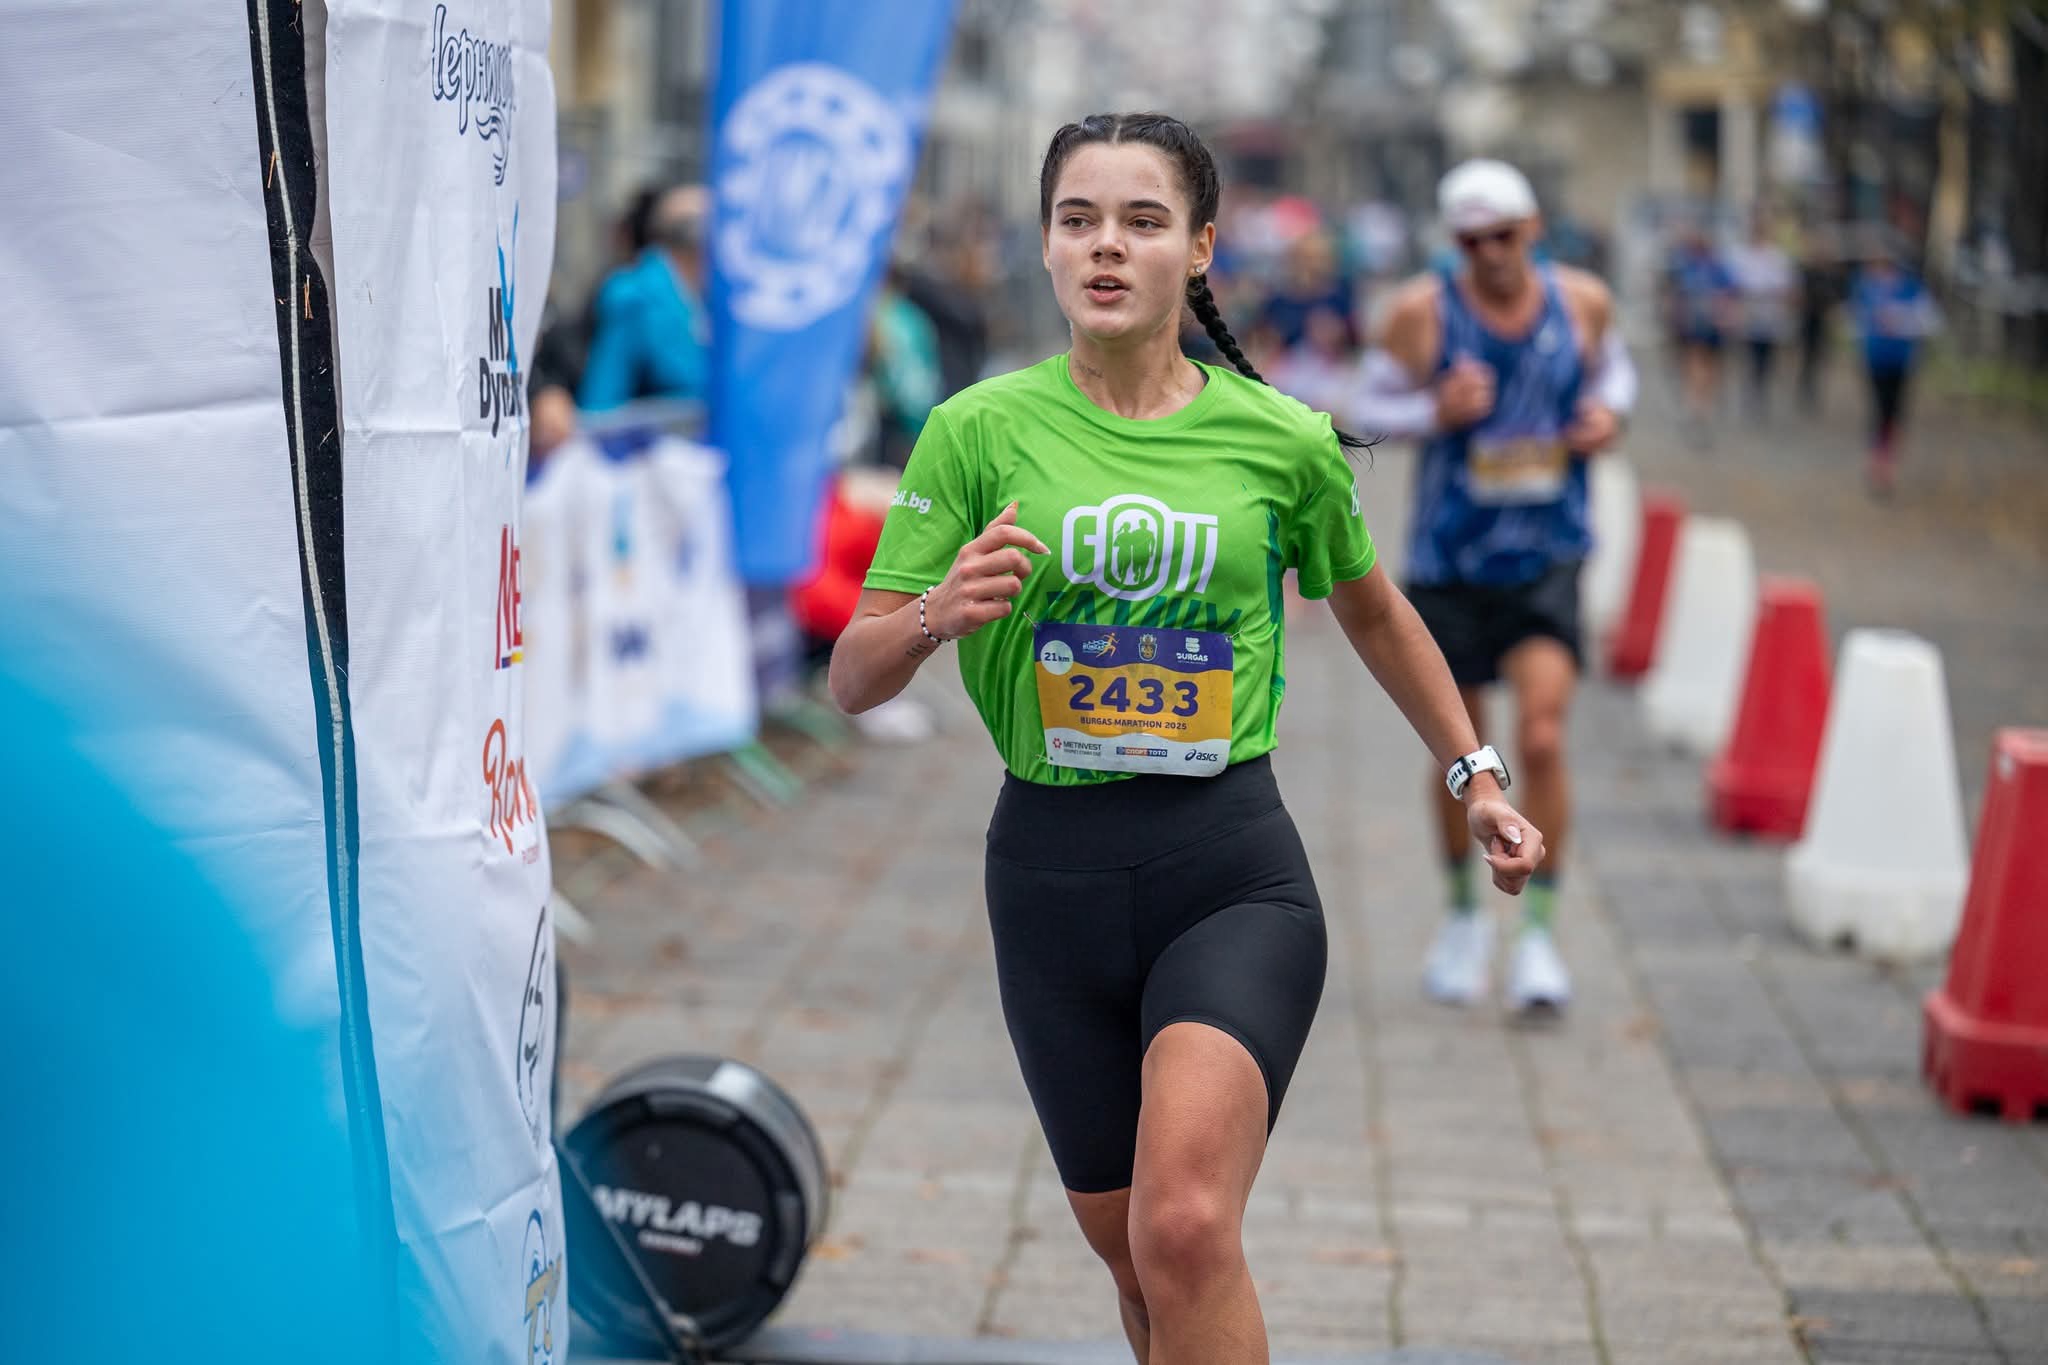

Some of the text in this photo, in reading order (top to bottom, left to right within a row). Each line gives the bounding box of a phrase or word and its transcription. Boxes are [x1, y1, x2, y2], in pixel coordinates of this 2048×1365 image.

[1044, 652, 1057, 663] 21
[1069, 674, 1199, 717] 2433
[1165, 721, 1187, 730] 2025
[1063, 740, 1102, 751] METINVEST
[593, 1184, 763, 1247] MYLAPS
